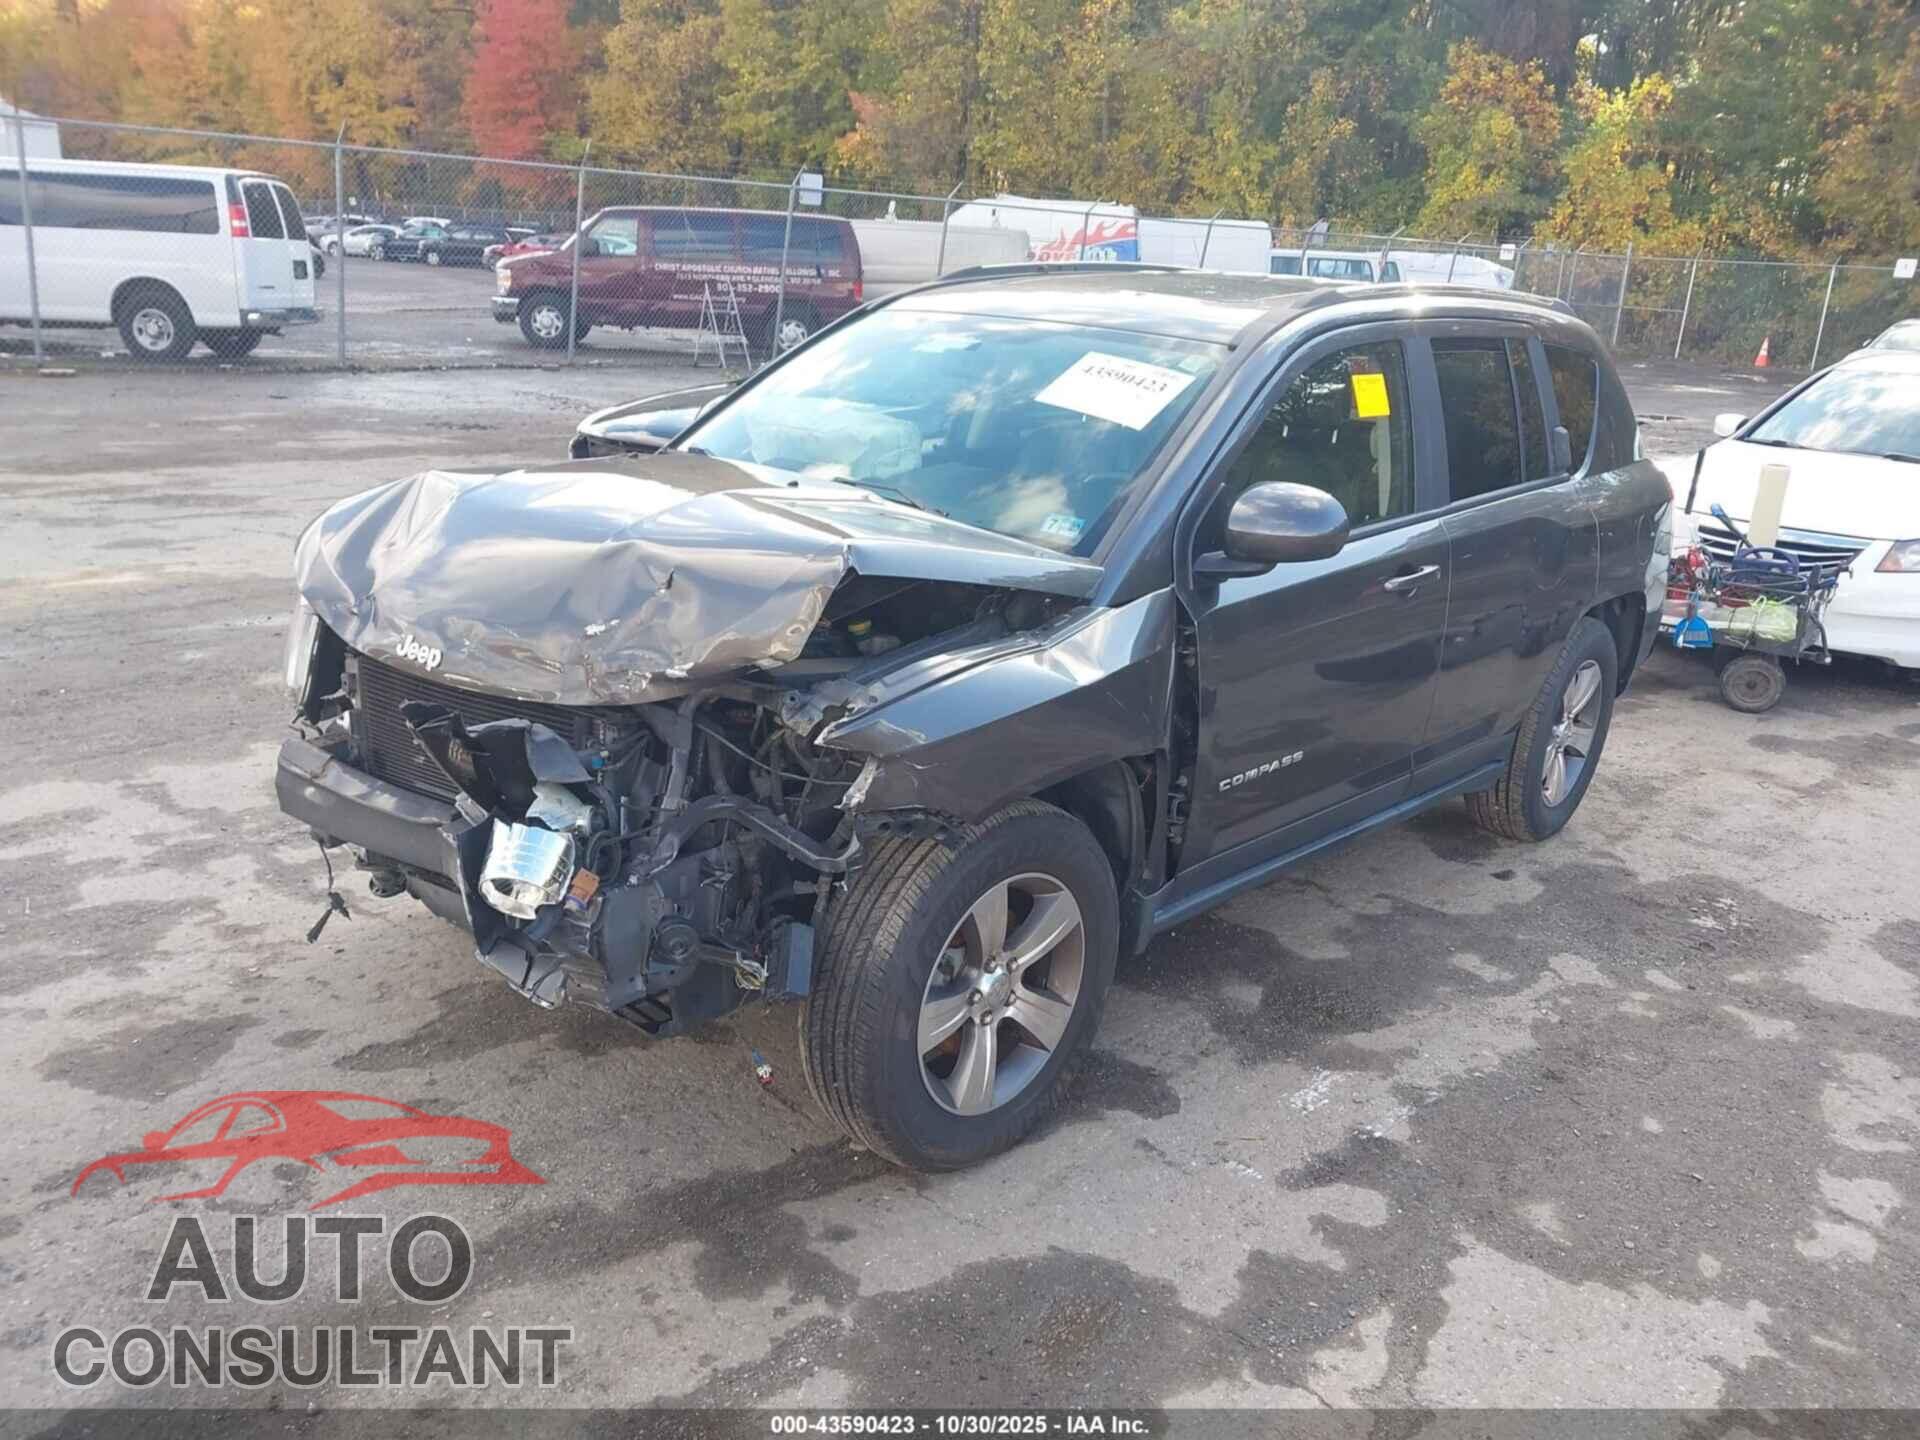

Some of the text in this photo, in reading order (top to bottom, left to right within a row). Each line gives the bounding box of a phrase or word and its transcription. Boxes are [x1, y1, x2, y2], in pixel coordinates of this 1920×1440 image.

[655, 263, 680, 272] CHRIST
[396, 634, 442, 672] Jeep
[1218, 750, 1304, 792] COMPASS
